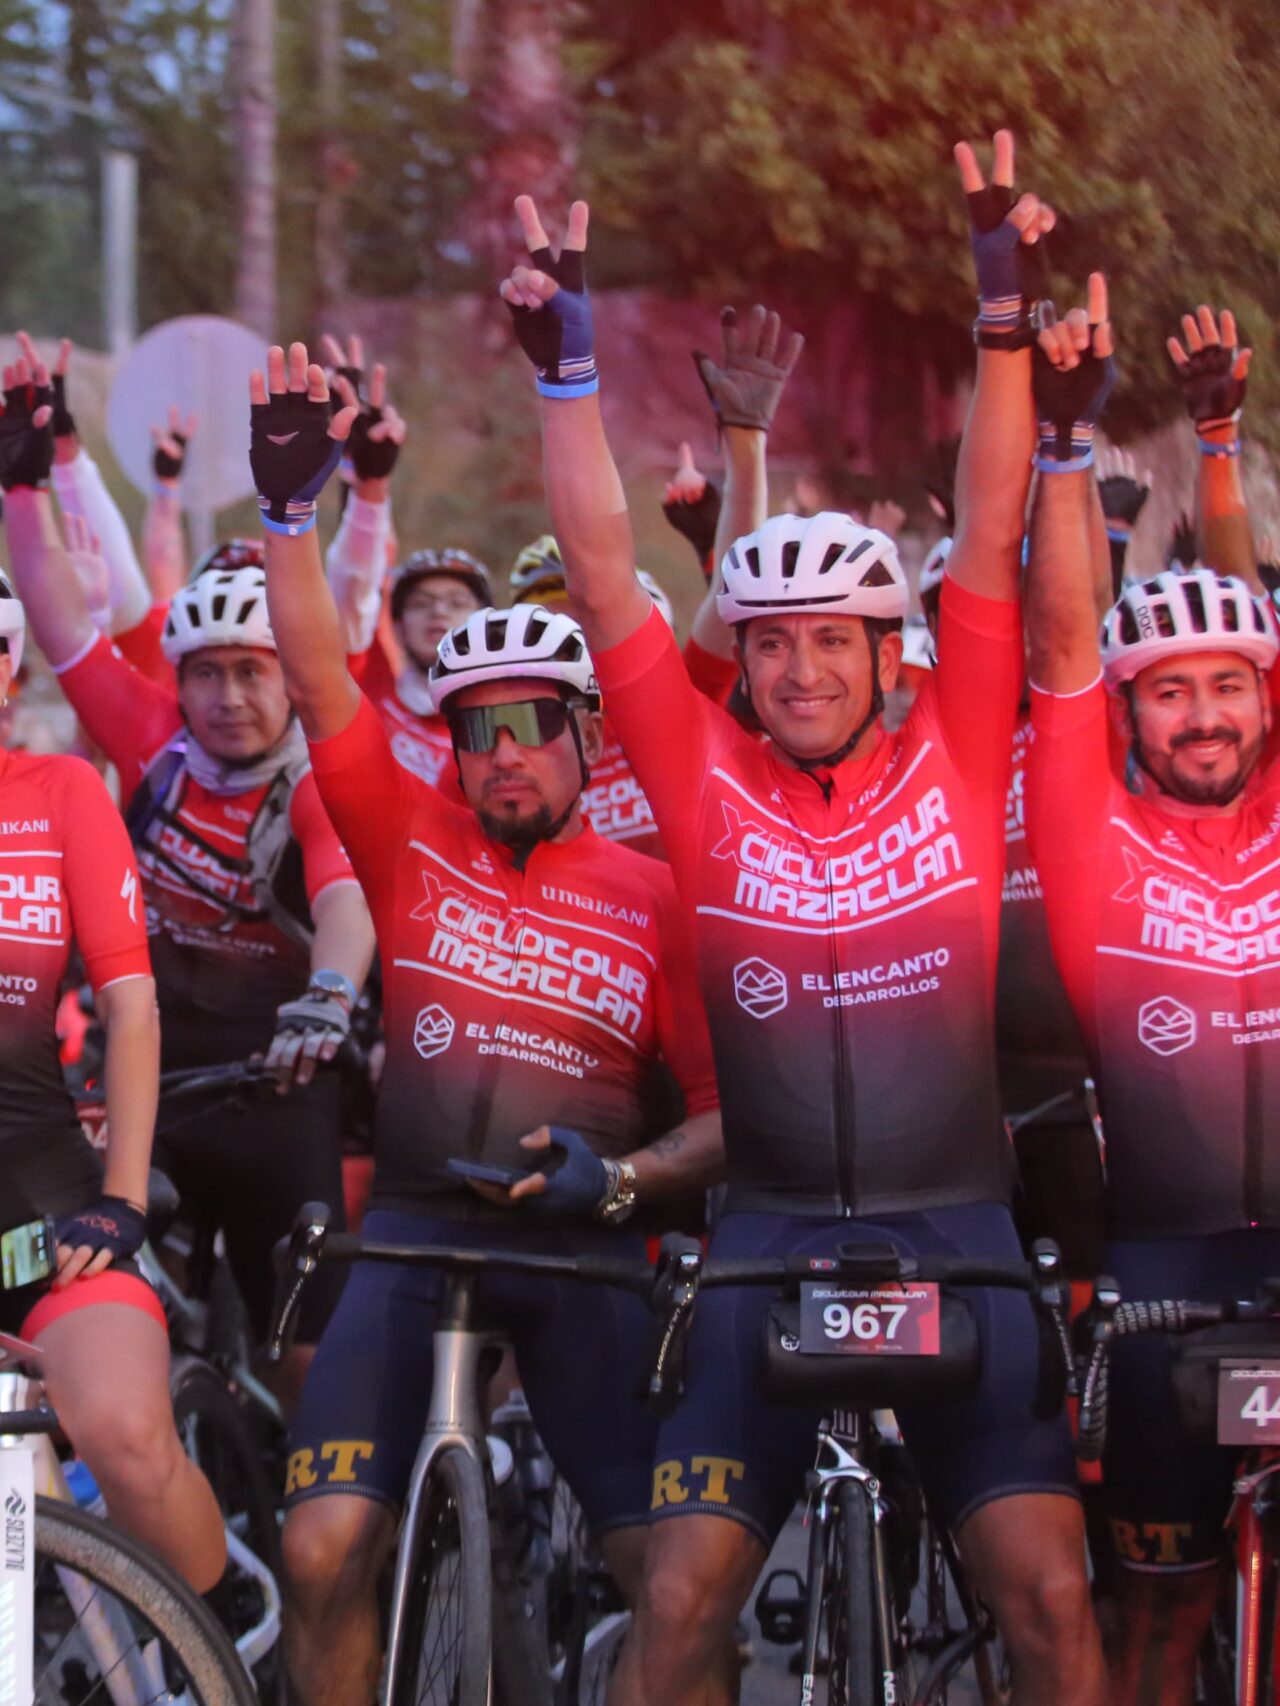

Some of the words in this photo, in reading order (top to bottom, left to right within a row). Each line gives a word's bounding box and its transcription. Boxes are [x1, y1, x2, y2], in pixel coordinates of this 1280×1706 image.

[740, 786, 951, 888] CICLOTOUR
[734, 831, 962, 922] MAZATLAN
[438, 897, 648, 1003] CICLOTOUR
[801, 973, 831, 991] EL
[833, 947, 950, 990] ENCANTO
[428, 928, 642, 1035] MAZATLAN
[823, 977, 940, 1008] DESARROLLOS
[465, 1022, 490, 1040] EL
[1211, 1011, 1241, 1028] EL
[478, 1043, 584, 1079] DESARROLLOS
[823, 1303, 907, 1340] 967
[284, 1440, 375, 1496] RT
[650, 1455, 745, 1510] RT
